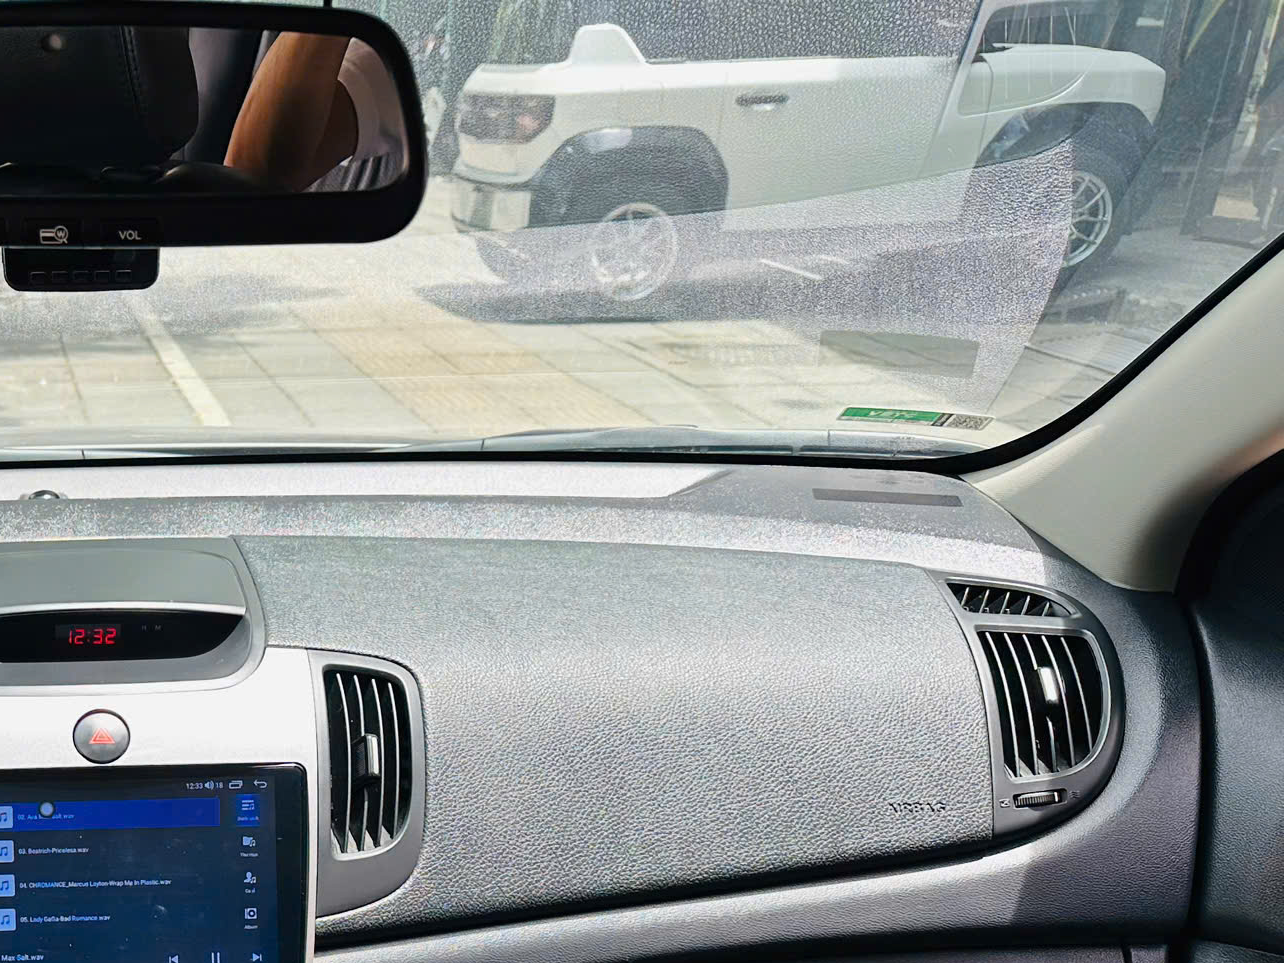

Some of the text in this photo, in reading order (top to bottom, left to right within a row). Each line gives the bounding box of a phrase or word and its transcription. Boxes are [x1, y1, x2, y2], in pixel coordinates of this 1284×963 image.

[118, 230, 142, 240] VOL
[68, 628, 117, 645] 12:32
[186, 782, 204, 790] 12:33
[1, 954, 15, 962] Max
